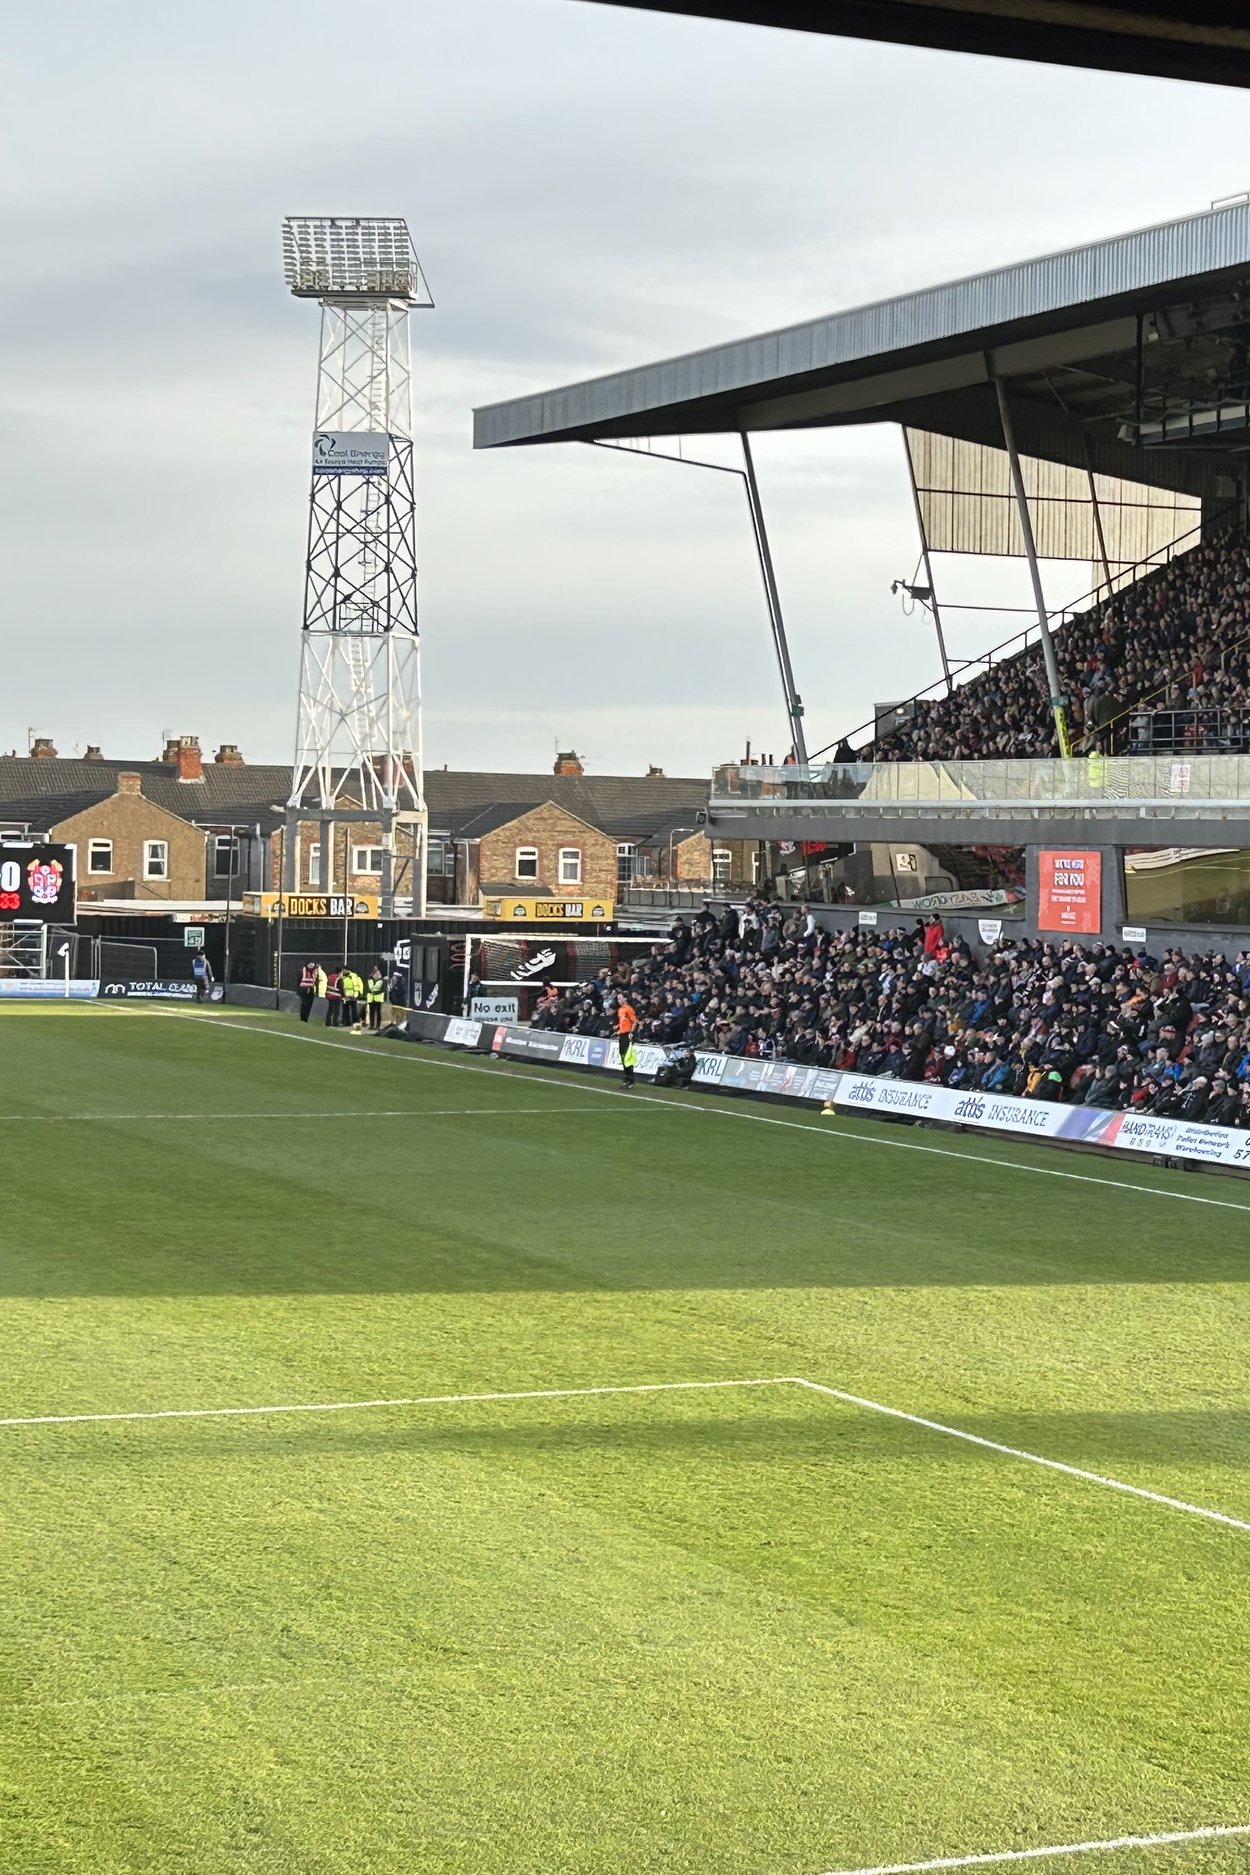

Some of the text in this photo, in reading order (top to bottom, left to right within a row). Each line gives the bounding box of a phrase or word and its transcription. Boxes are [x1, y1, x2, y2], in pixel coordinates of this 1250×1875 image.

[327, 449, 348, 457] Cool
[2, 862, 20, 892] 0
[290, 898, 353, 916] DOCKS BAR
[129, 982, 167, 992] TOTAL
[474, 1003, 516, 1013] No exit
[567, 1039, 586, 1058] KRL
[698, 1058, 722, 1077] KRL
[877, 1088, 932, 1110] INSURANCE
[954, 1096, 1050, 1128] attis INSURANCE
